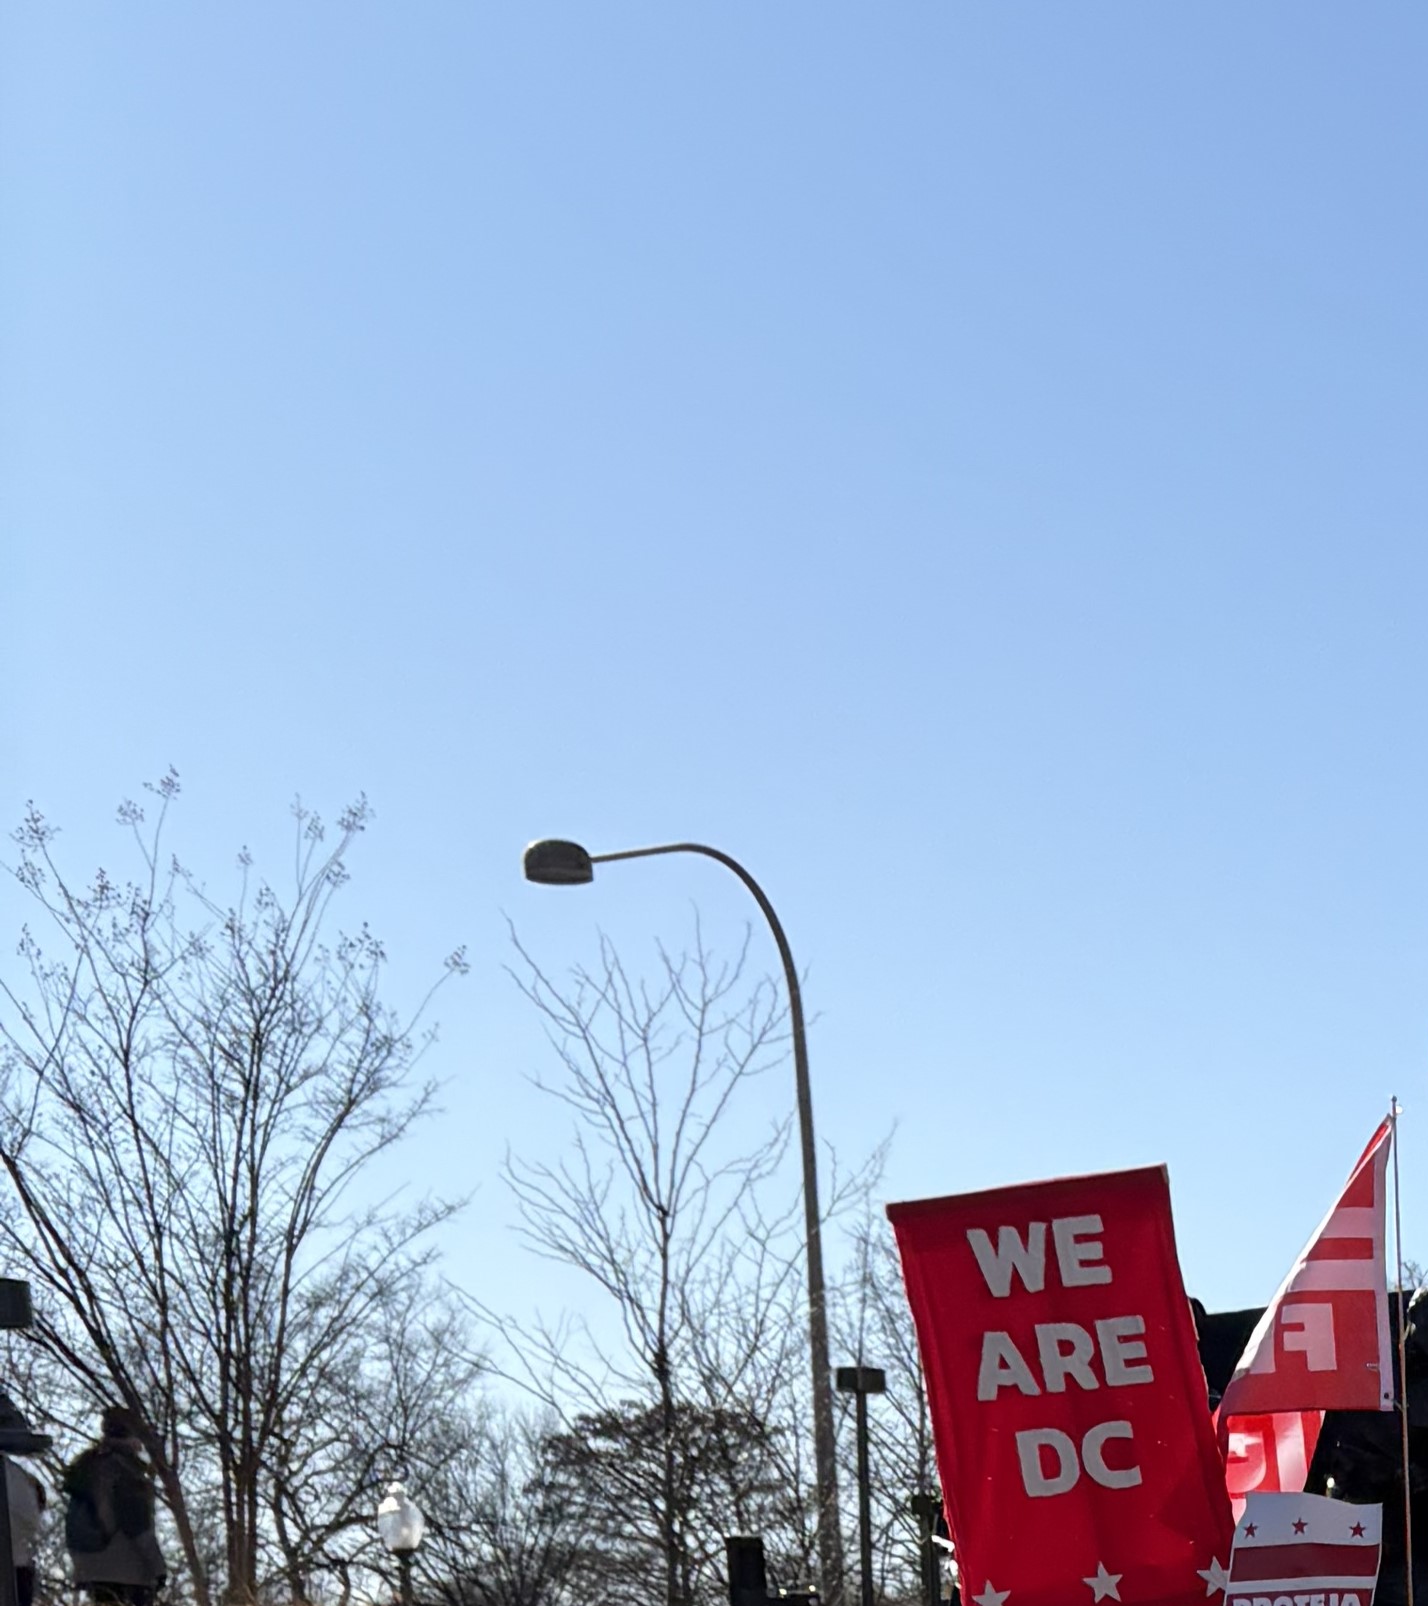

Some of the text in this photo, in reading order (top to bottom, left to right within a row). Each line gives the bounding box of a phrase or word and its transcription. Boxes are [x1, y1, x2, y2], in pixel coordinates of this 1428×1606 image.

[967, 1214, 1112, 1298] WE
[977, 1315, 1154, 1401] ARE
[1015, 1420, 1143, 1497] DC
